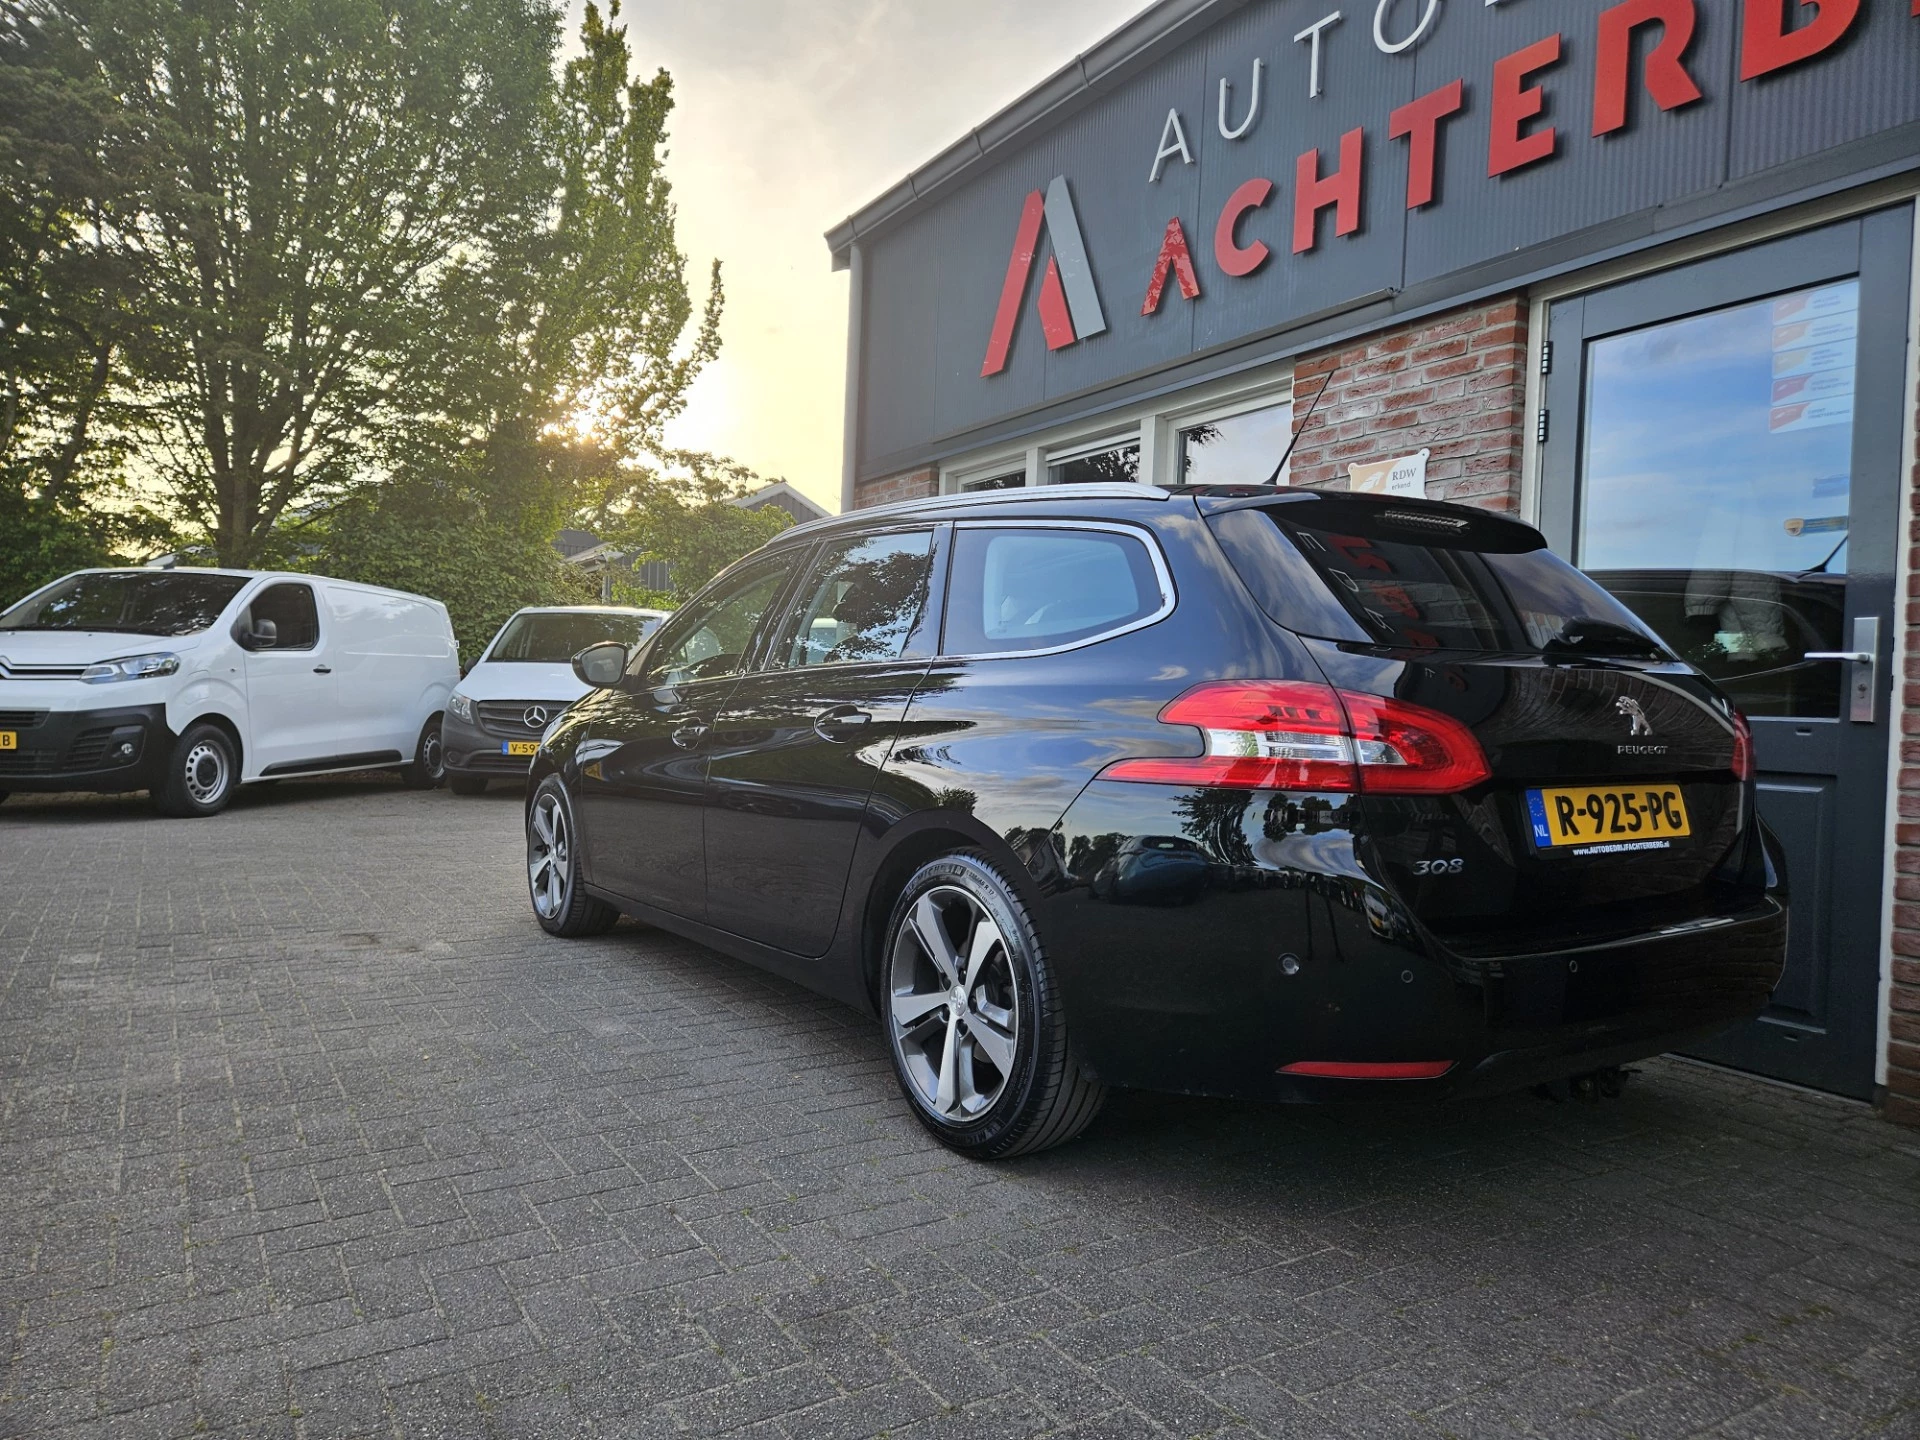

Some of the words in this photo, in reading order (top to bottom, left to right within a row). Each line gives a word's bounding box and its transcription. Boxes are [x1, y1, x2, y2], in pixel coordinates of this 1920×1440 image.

[1392, 468, 1417, 481] RDW
[1391, 482, 1411, 490] erkend
[511, 743, 540, 753] V-59
[1617, 745, 1668, 755] PEUGEOT
[1554, 791, 1683, 837] R-925-PG
[1534, 824, 1549, 837] NL
[1412, 858, 1464, 875] 308
